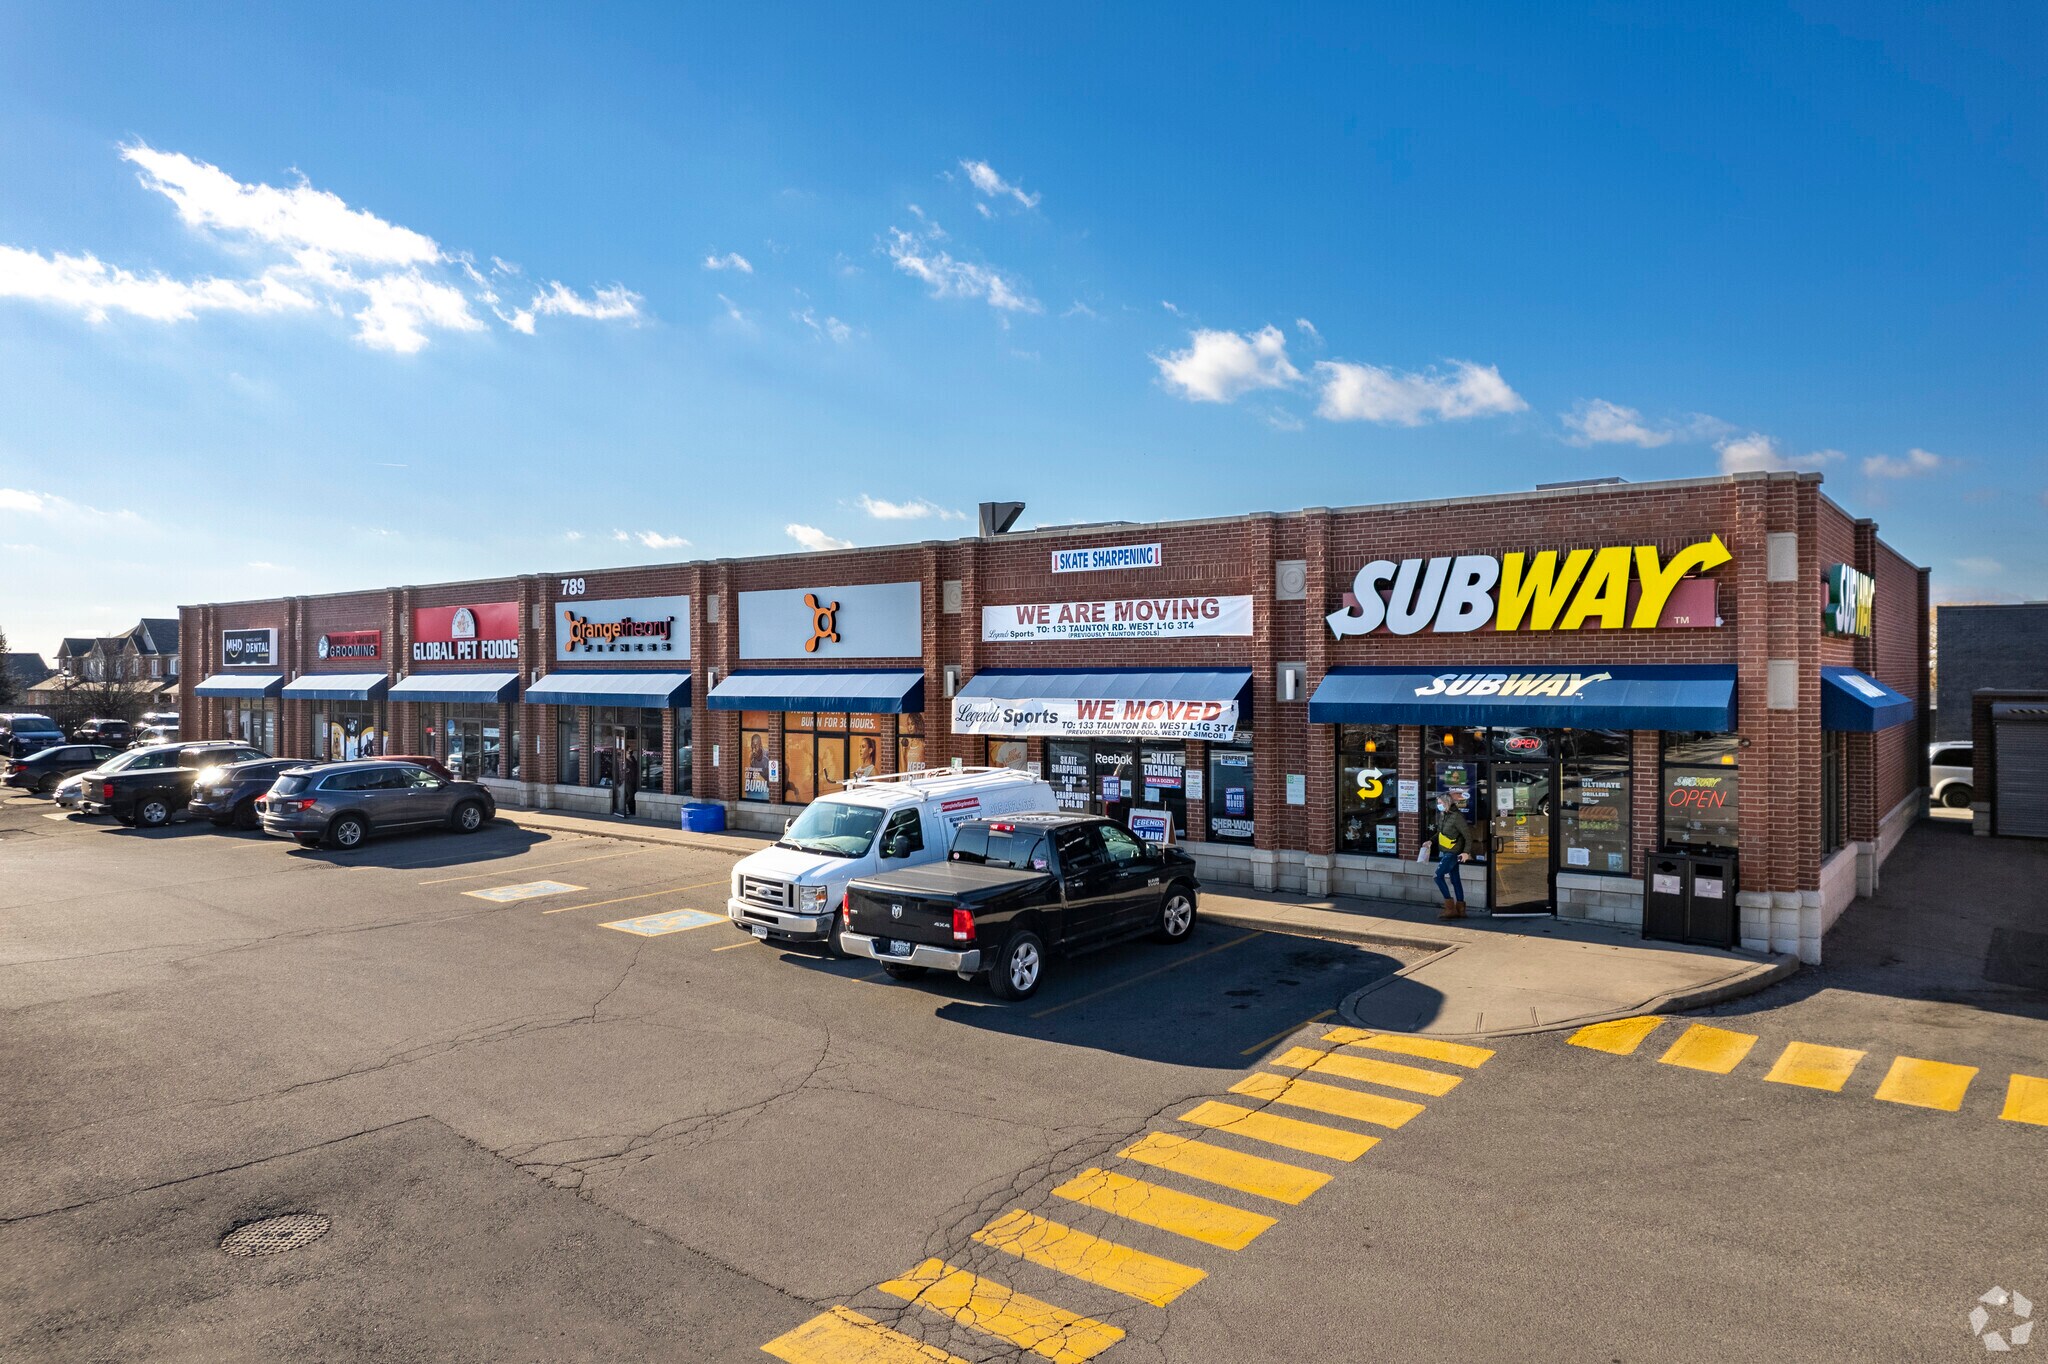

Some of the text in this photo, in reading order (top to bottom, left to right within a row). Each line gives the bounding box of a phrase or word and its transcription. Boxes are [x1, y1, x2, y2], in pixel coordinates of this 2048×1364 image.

[1060, 546, 1153, 570] SKATE SHARPENING
[561, 577, 586, 596] 789
[1326, 533, 1733, 641] SUBWAY
[1016, 598, 1220, 625] WE ARE MOVING
[1674, 616, 1690, 624] TM
[1036, 621, 1195, 633] TO: 133 TAUNTON RD. WEST L1G 3T4
[1010, 630, 1035, 639] Sports
[226, 638, 243, 652] MHD
[245, 642, 269, 653] DENTAL
[329, 645, 375, 657] GROOMING
[413, 639, 518, 660] GLOBAL PET FOODS
[584, 642, 672, 652] FITNESS
[1414, 671, 1612, 697] SUBWAY
[955, 700, 1222, 728] Legends Sports WE MOVED
[824, 718, 838, 729] FOR
[850, 718, 876, 730] HOURS.
[1062, 721, 1234, 733] TO: 133 TAUNTON RD. WEST L1G 3T4
[1193, 731, 1227, 740] SIMCOE)
[1510, 738, 1540, 749] OPEN
[1060, 755, 1078, 765] SKATE
[1095, 753, 1133, 765] Reebok
[1151, 752, 1175, 765] SKATE
[907, 761, 926, 772] KEEP
[1051, 764, 1087, 775] SHARPENING
[1144, 764, 1182, 777] EXCHANGE
[1061, 775, 1077, 784] $4.00
[1674, 776, 1722, 788] SUBWAY
[745, 779, 770, 793] BURN.
[1056, 791, 1090, 801] SHARPENINGS
[1668, 788, 1727, 809] OPEN
[1145, 831, 1164, 841] HAVE
